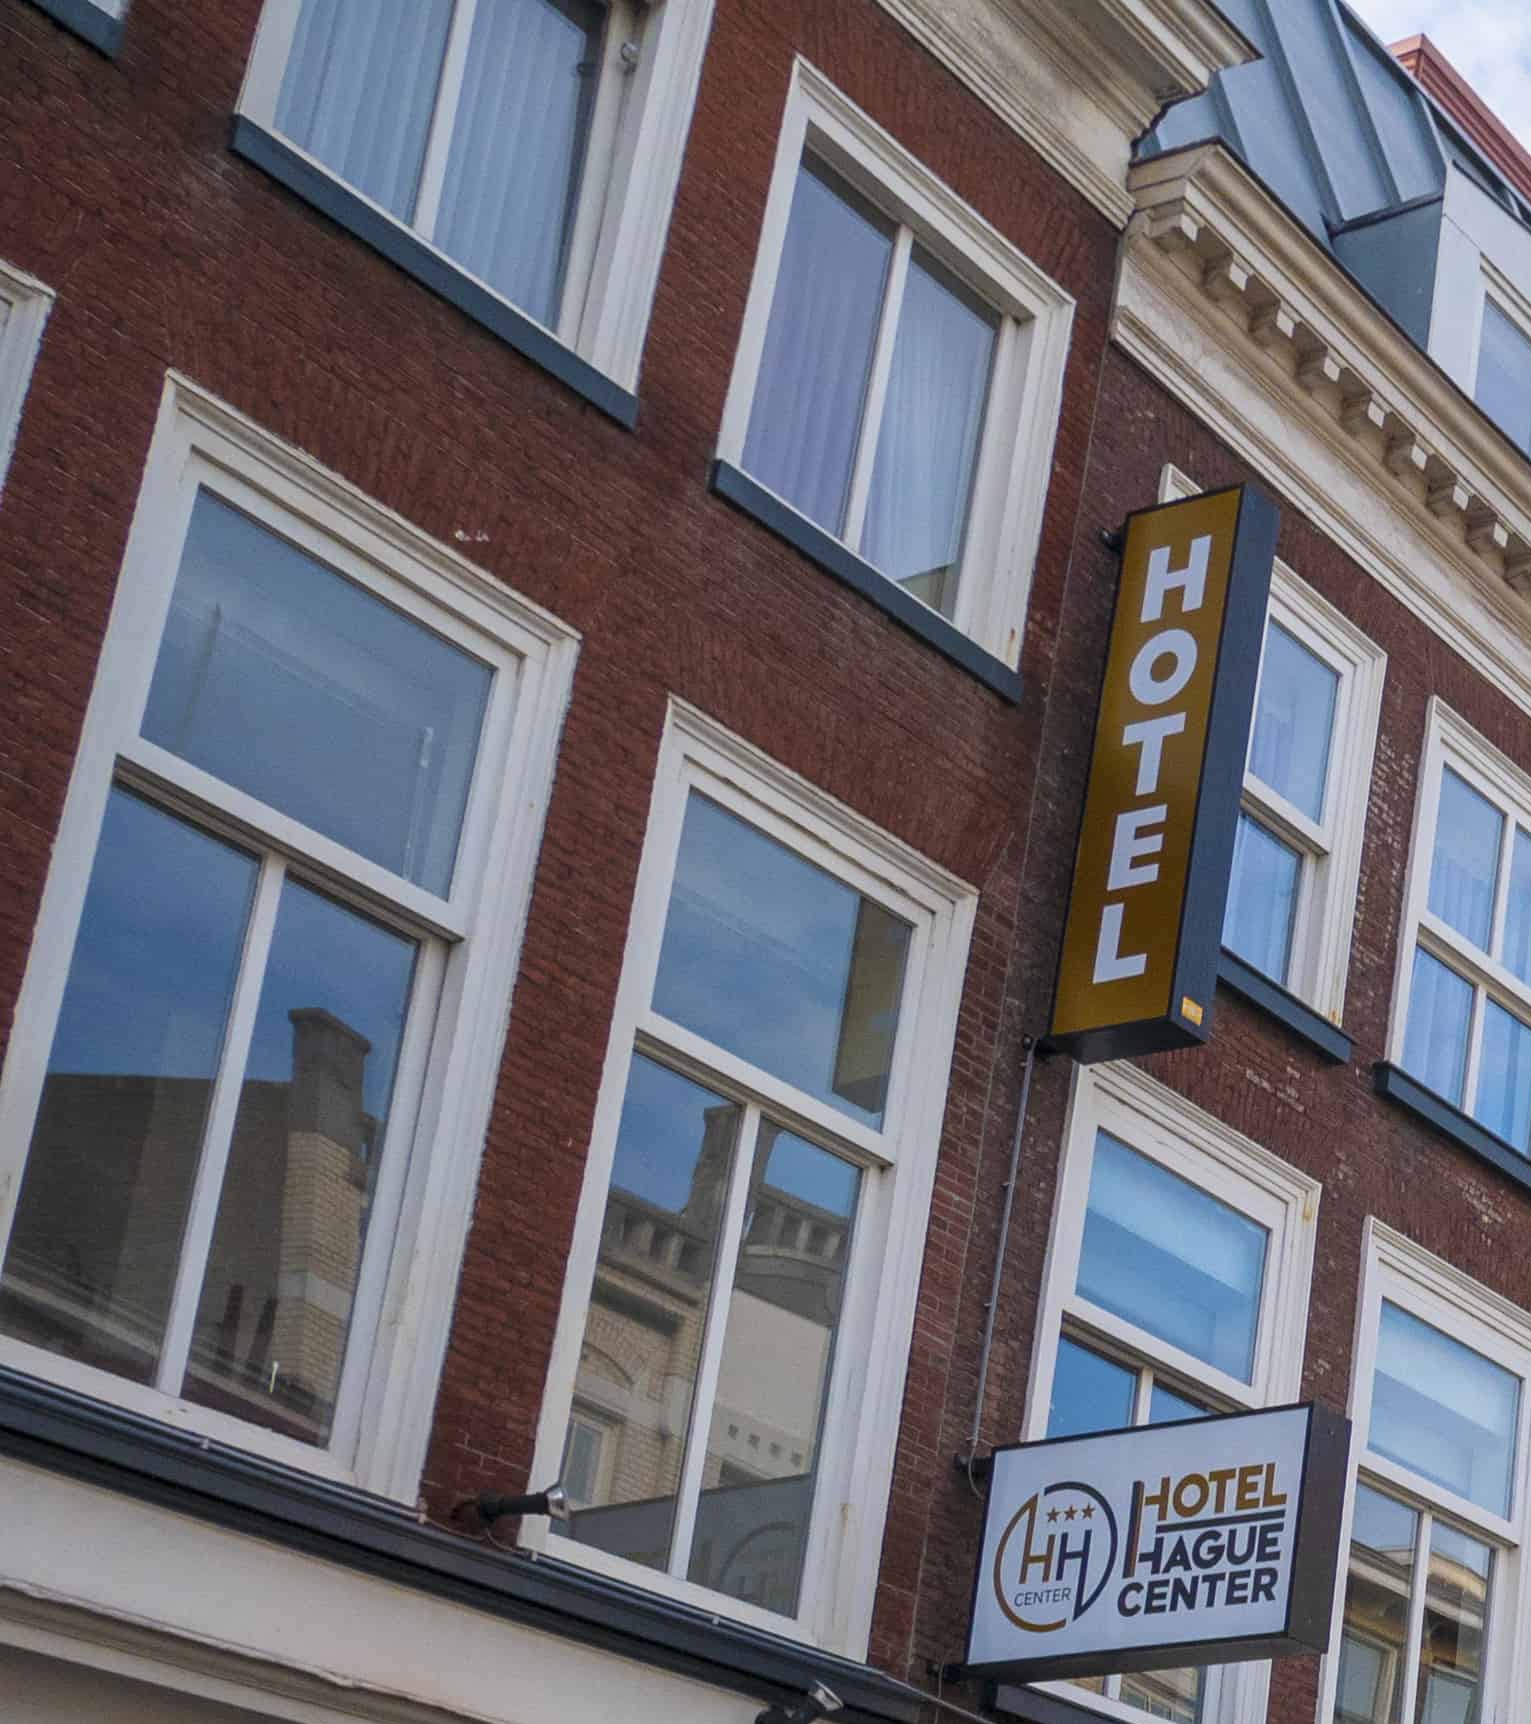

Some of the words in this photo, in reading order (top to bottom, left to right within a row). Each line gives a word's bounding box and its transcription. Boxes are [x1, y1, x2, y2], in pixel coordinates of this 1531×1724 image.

[1092, 535, 1212, 984] HOTEL
[1136, 1463, 1287, 1522] HOTEL
[1123, 1521, 1285, 1579] HAGUE
[1013, 1587, 1072, 1608] CENTER
[1117, 1567, 1279, 1618] CENTER
